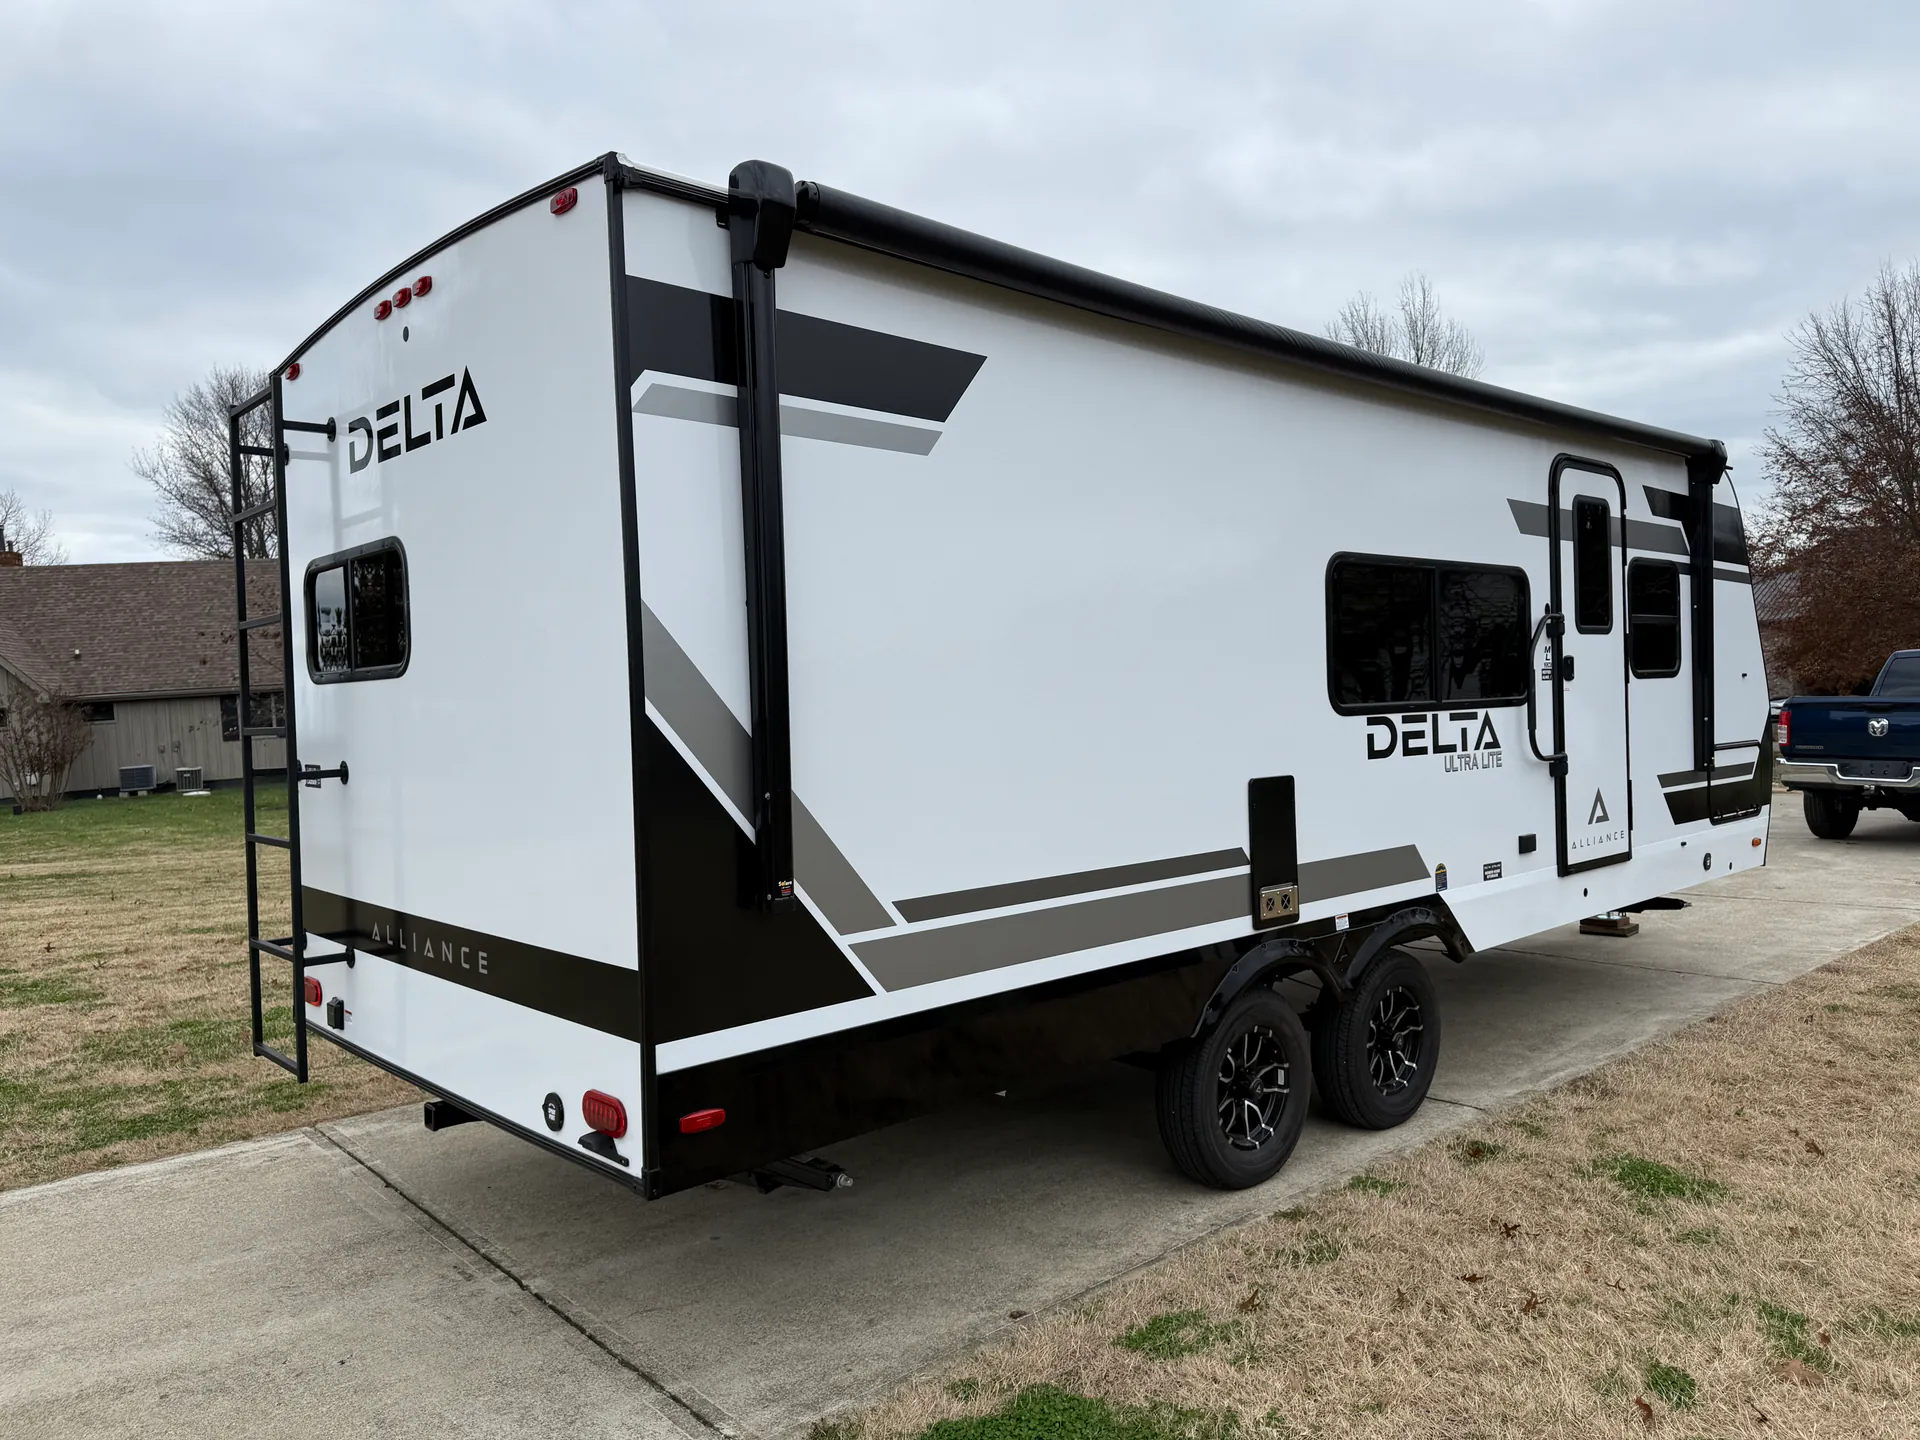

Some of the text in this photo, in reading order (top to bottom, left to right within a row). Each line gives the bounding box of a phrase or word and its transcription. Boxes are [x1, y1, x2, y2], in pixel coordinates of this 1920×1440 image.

[348, 365, 488, 475] DELTA
[1366, 710, 1502, 760] DELTA
[1444, 750, 1503, 773] ULTRA LITE
[1571, 830, 1625, 850] ALLIANCE
[371, 921, 490, 976] ALLIANCE
